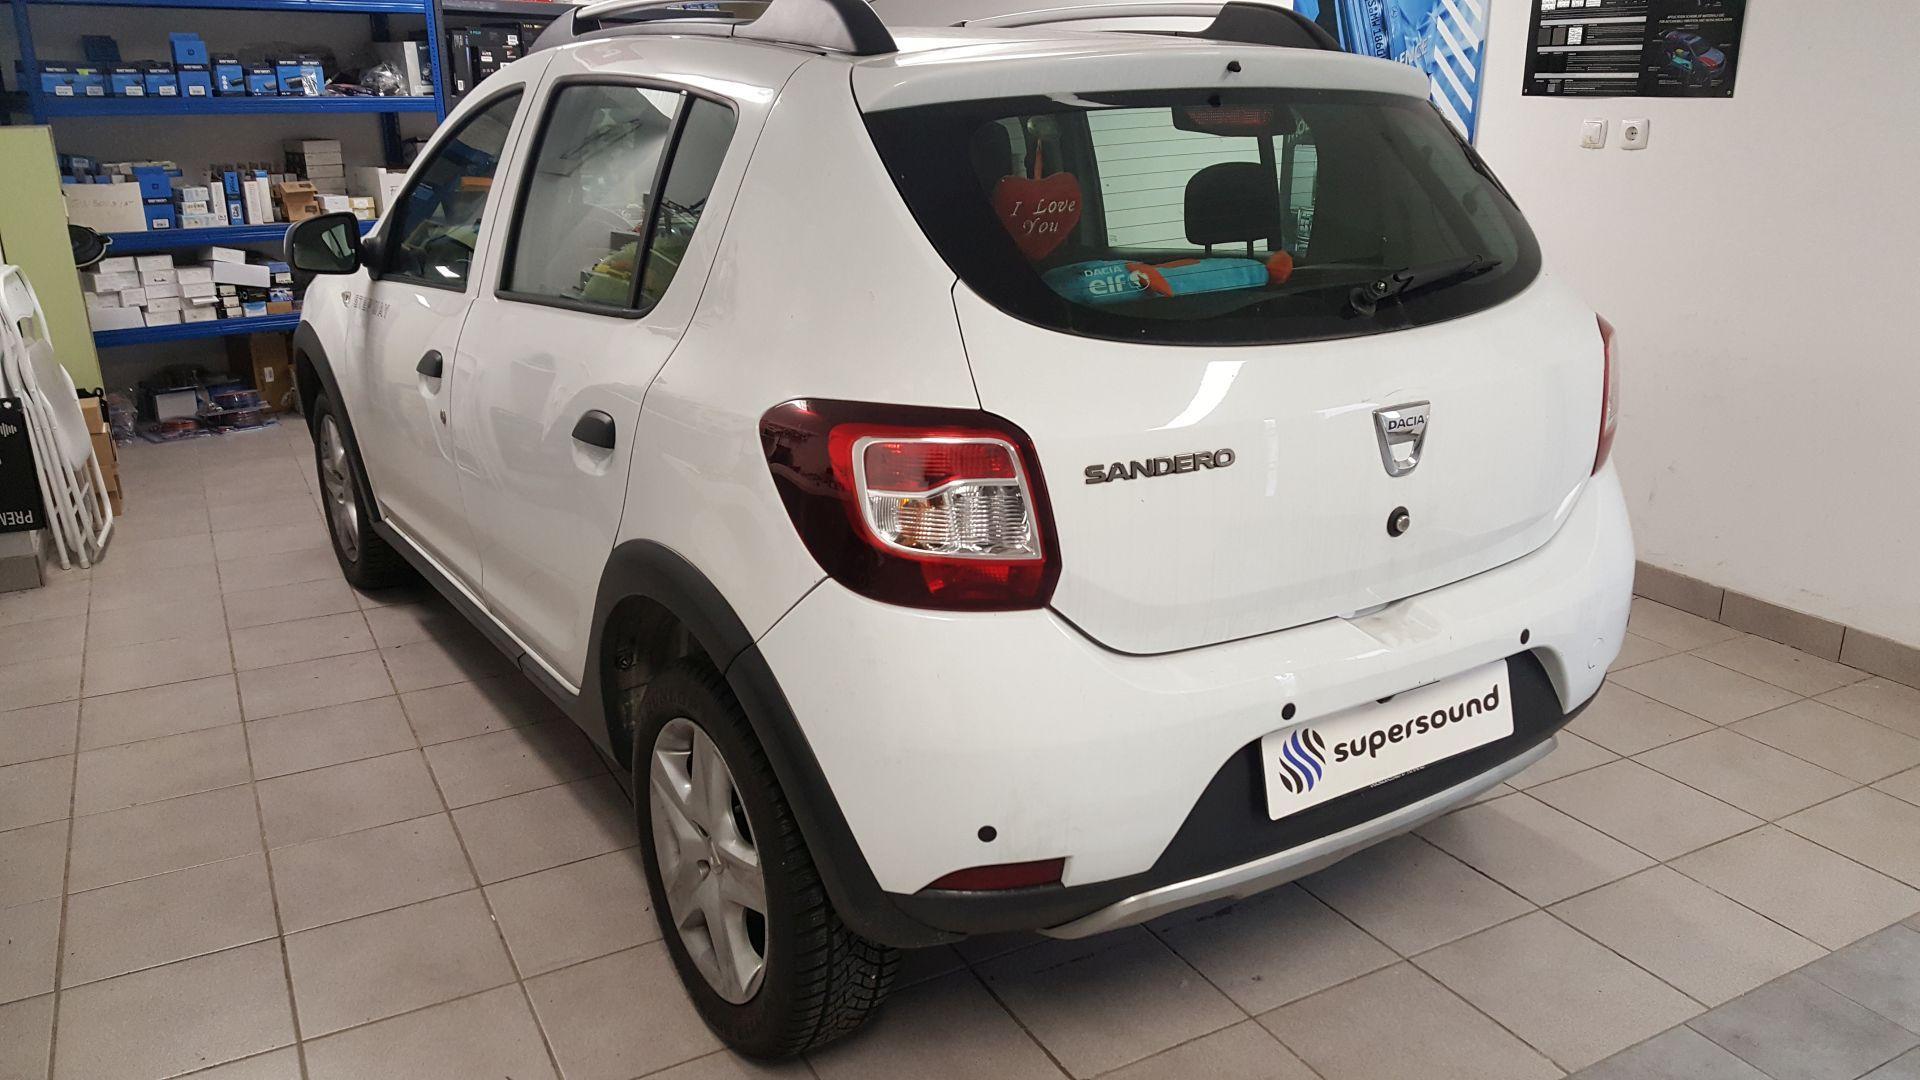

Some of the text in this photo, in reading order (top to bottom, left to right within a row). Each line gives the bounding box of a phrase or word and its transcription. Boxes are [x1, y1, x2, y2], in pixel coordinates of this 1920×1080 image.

[1372, 28, 1387, 59] 1860
[1010, 199, 1076, 216] I Love
[1022, 218, 1058, 234] You
[1084, 265, 1123, 277] DACIA
[1089, 274, 1126, 295] elf
[1388, 415, 1424, 430] DACIA
[1084, 448, 1236, 484] SANDERO
[1333, 684, 1500, 762] supersound
